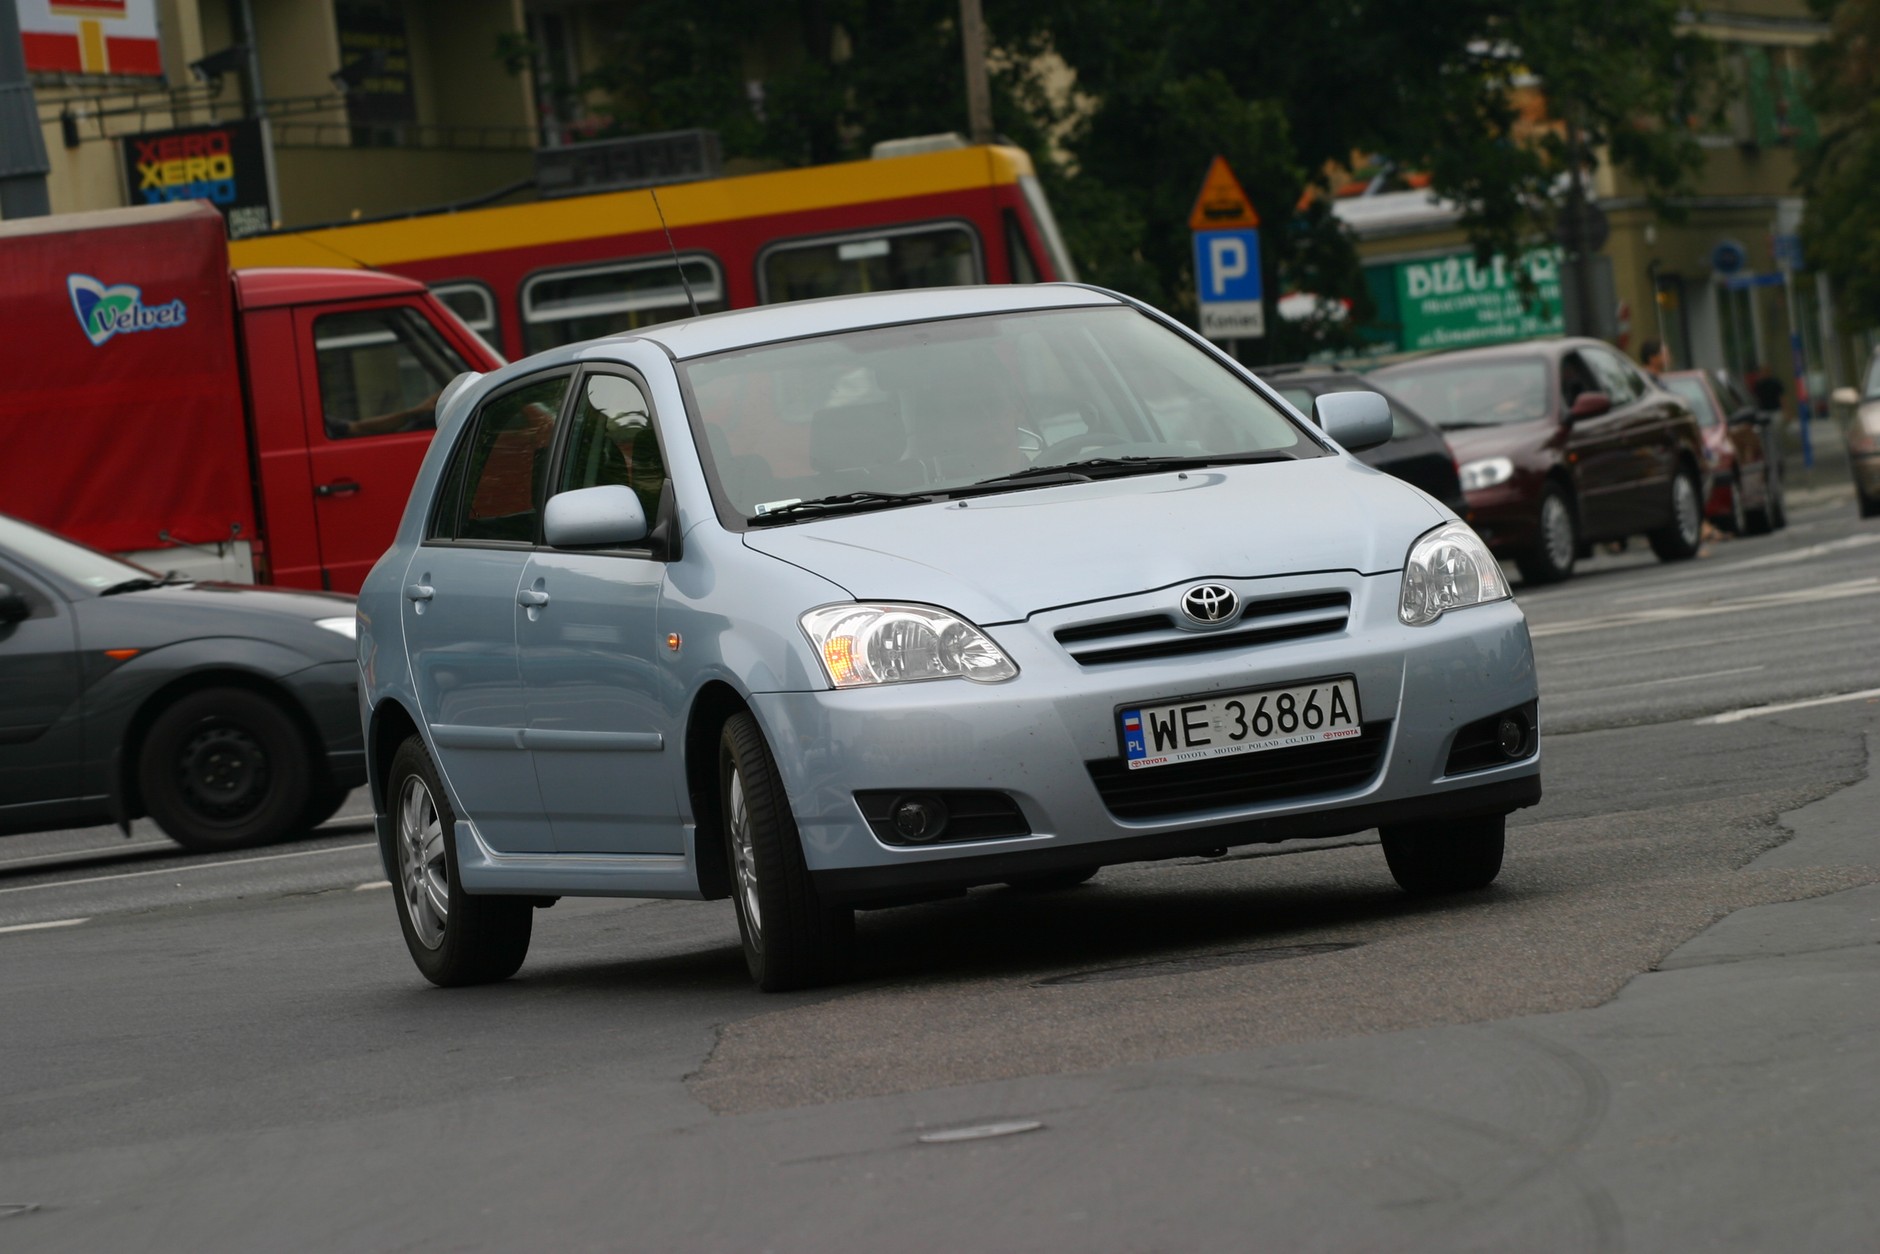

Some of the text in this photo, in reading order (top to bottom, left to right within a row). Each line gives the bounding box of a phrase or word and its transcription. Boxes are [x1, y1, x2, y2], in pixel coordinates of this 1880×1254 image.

[135, 131, 229, 162] XERO
[137, 153, 234, 190] XERO
[1210, 237, 1248, 296] P
[95, 302, 186, 333] Velvet
[1150, 685, 1352, 751] WE 3686A
[1333, 729, 1359, 738] TOYOTA
[1128, 741, 1143, 752] PL
[1141, 757, 1168, 766] TOYOTA
[1176, 751, 1208, 760] TOYOTA
[1213, 745, 1242, 755] MOTOR
[1248, 740, 1279, 750] POLAND
